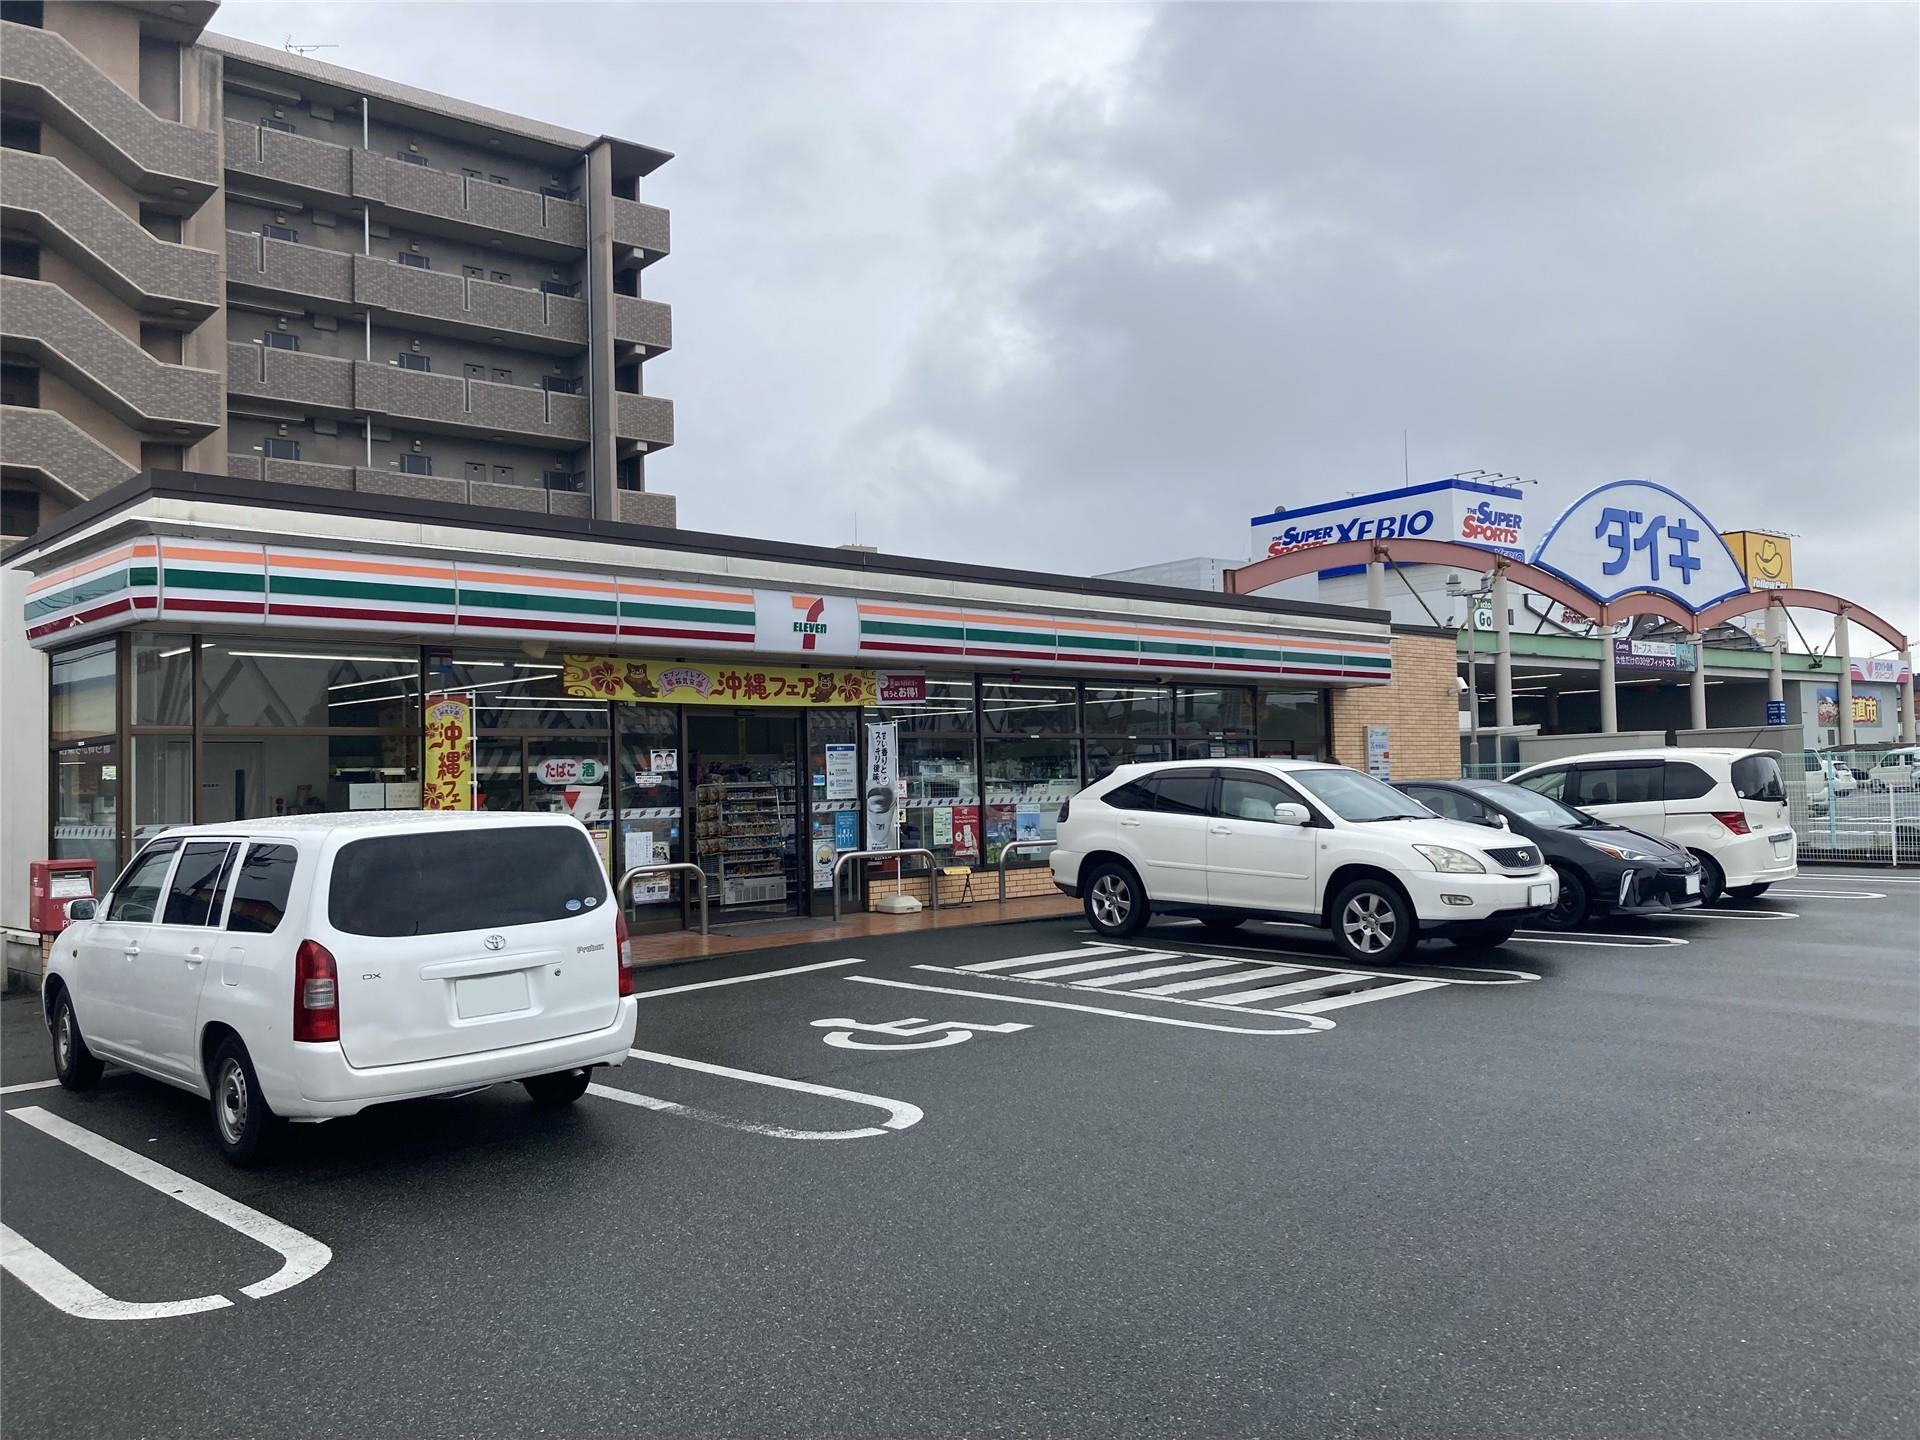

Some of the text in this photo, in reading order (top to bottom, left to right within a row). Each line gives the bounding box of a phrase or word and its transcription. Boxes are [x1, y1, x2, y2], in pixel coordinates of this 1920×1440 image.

[1282, 526, 1334, 547] SUPER
[1336, 510, 1434, 543] XEBIO
[1467, 501, 1522, 529] THE SUPER
[1462, 515, 1518, 544] SPORTS
[1595, 507, 1701, 585] ダイキ
[1615, 655, 1676, 668] 女性だけの30分フィットネス
[1633, 644, 1653, 654] カーブス
[709, 670, 815, 700] 沖縄フェア
[545, 762, 596, 778] たばこ 酒
[362, 972, 382, 981] DX
